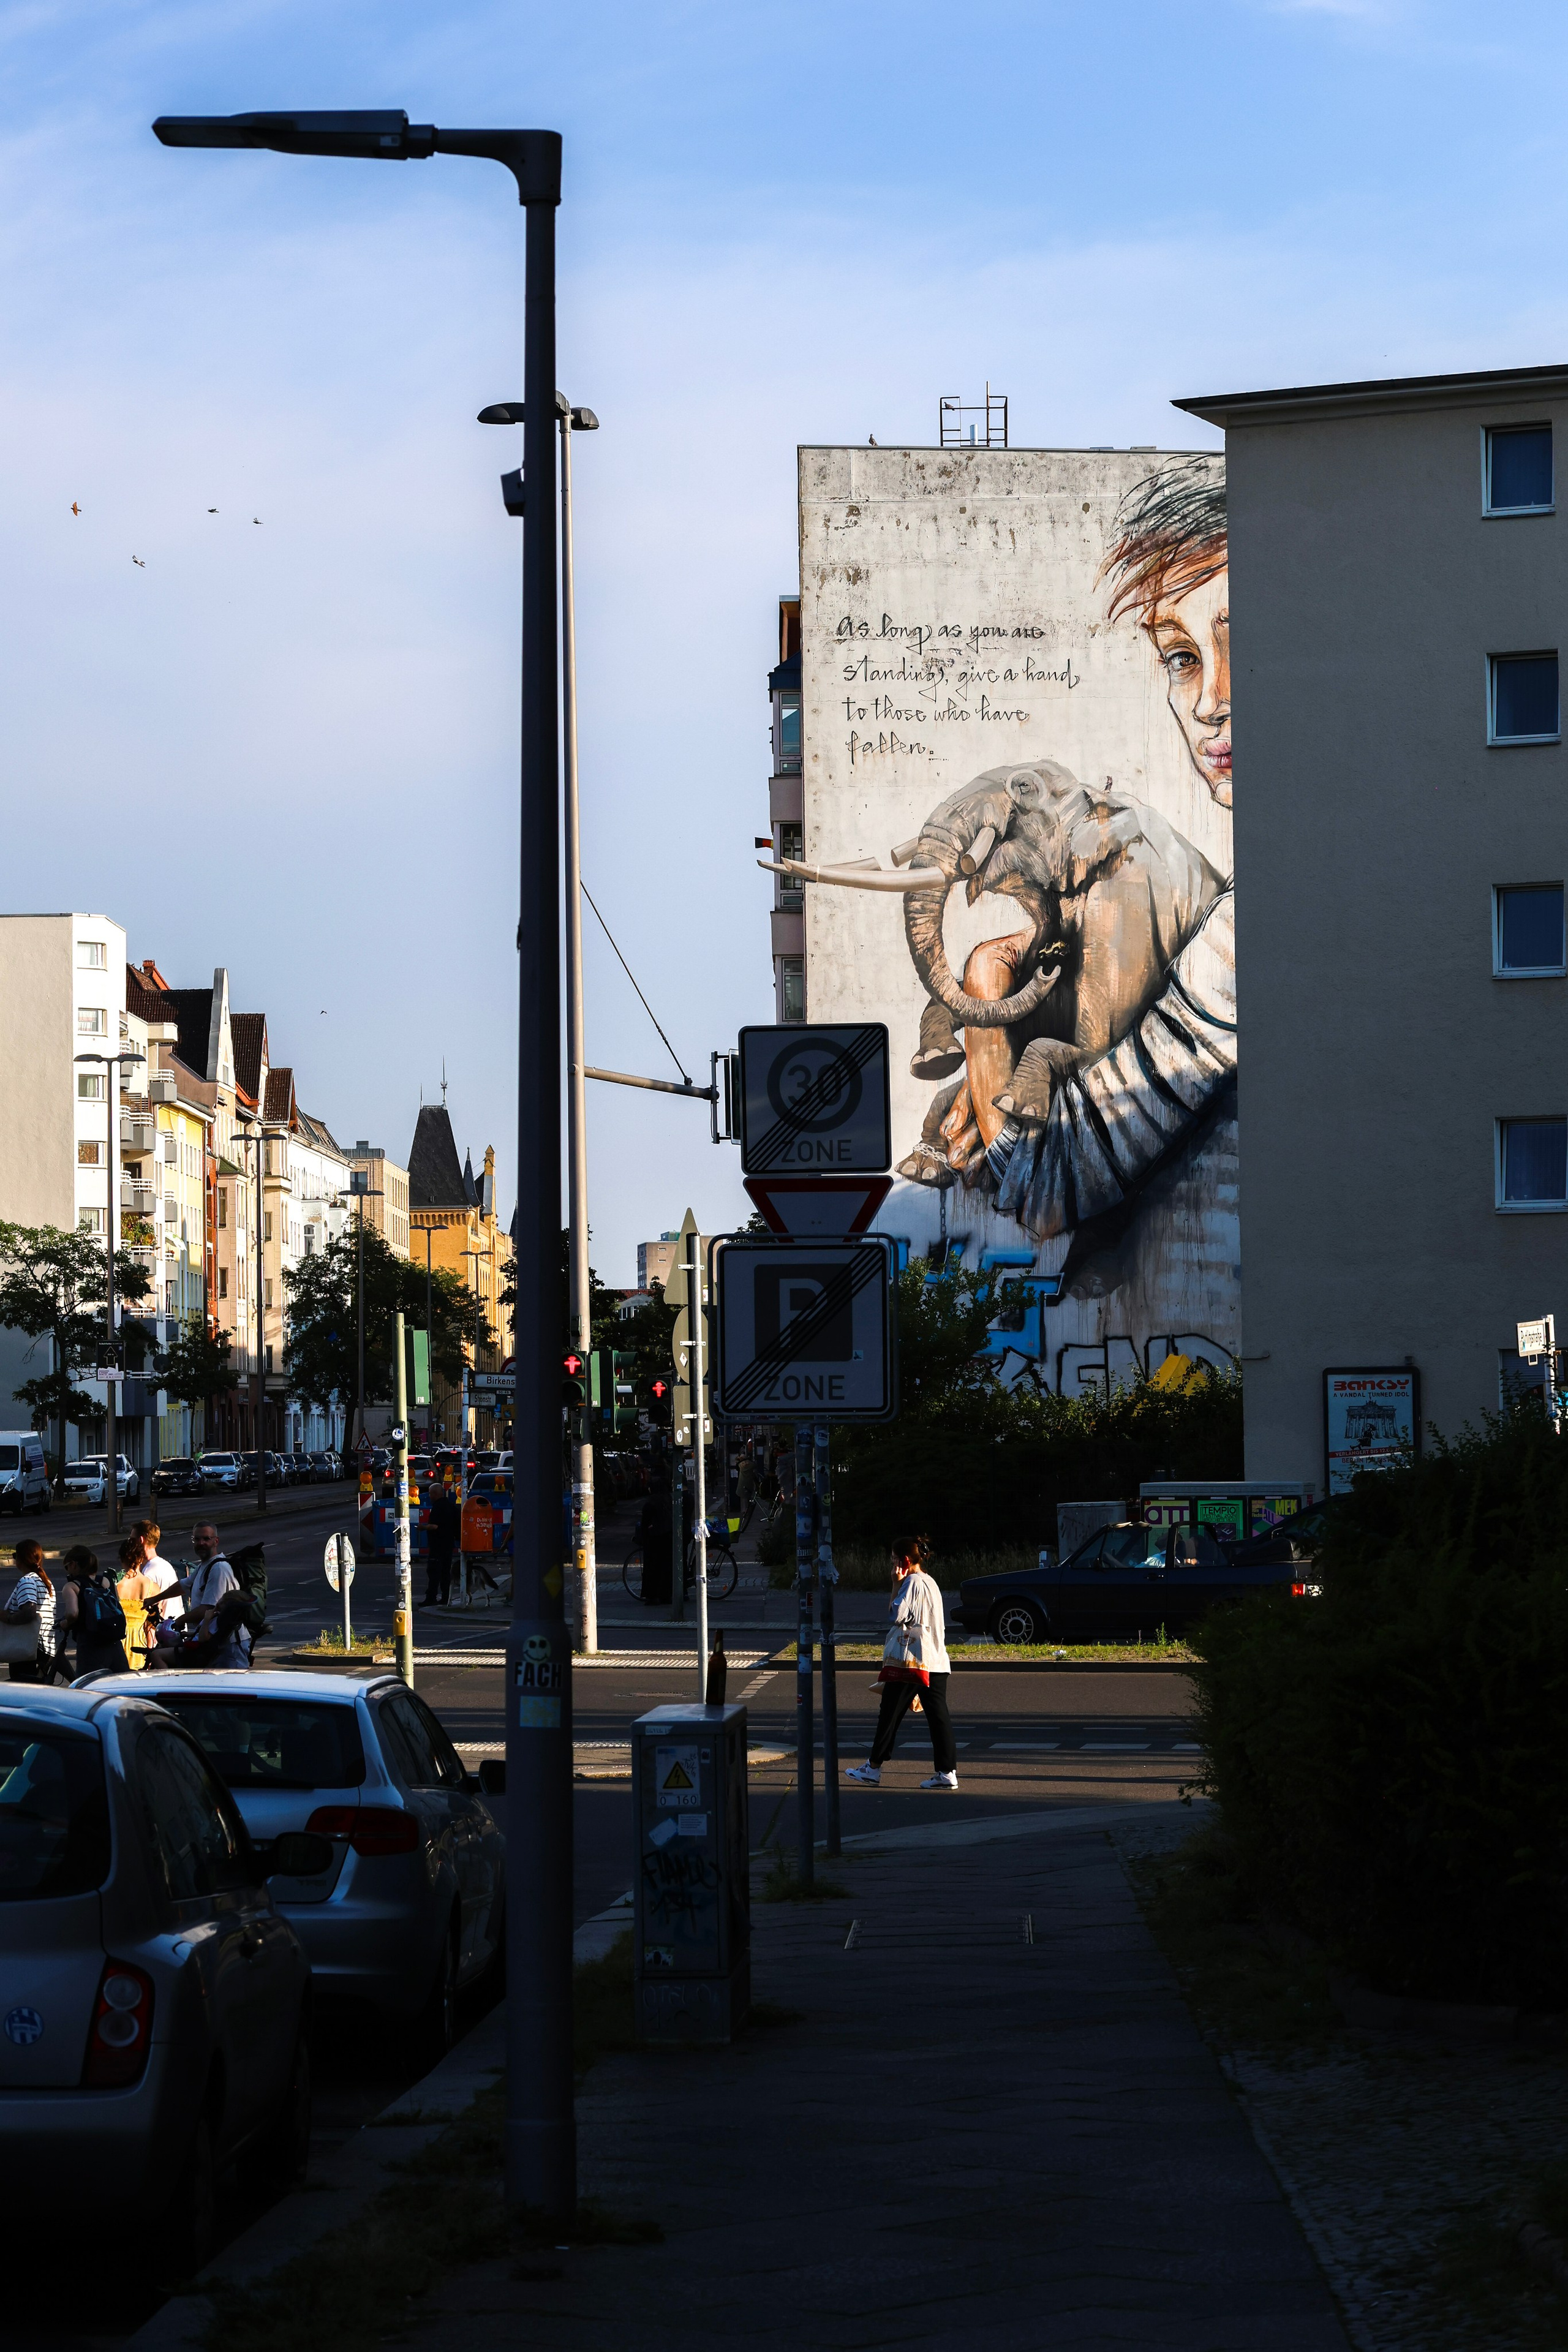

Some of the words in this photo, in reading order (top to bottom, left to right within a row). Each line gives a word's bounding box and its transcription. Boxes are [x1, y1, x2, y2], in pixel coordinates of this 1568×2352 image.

[876, 612, 932, 655] long
[938, 624, 962, 638] as
[966, 624, 1008, 653] you
[1011, 625, 1046, 639] are
[956, 665, 1000, 701] give
[1003, 671, 1019, 682] a
[1021, 656, 1080, 689] hand
[842, 696, 869, 722] to
[870, 695, 927, 722] those
[934, 697, 970, 720] who
[975, 694, 1030, 722] have
[787, 1063, 842, 1106] 30
[781, 1139, 853, 1163] ZONE
[778, 1277, 829, 1349] P
[764, 1374, 845, 1401] ZONE
[1334, 1379, 1409, 1391] BANKSY
[514, 1661, 563, 1687] FACH
[677, 1795, 697, 1804] 160
